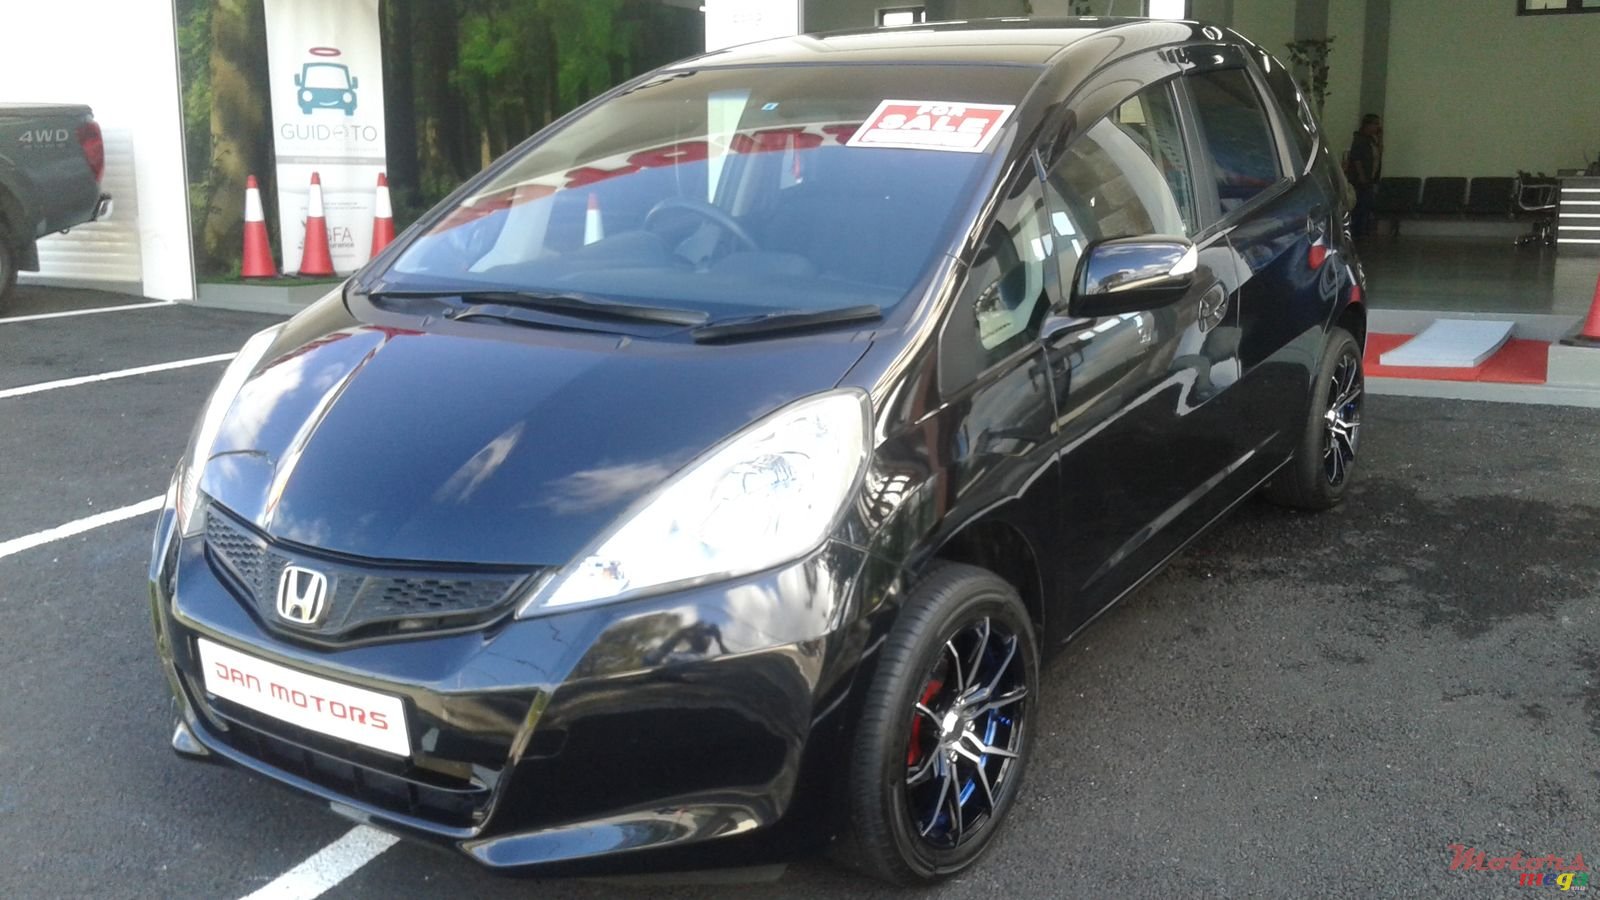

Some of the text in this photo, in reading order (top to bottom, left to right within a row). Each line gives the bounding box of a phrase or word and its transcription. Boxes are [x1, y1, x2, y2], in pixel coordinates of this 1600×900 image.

[916, 105, 966, 117] FOR
[877, 114, 989, 132] SALE
[18, 128, 69, 143] 4WD
[215, 662, 388, 730] JAN MOTORS
